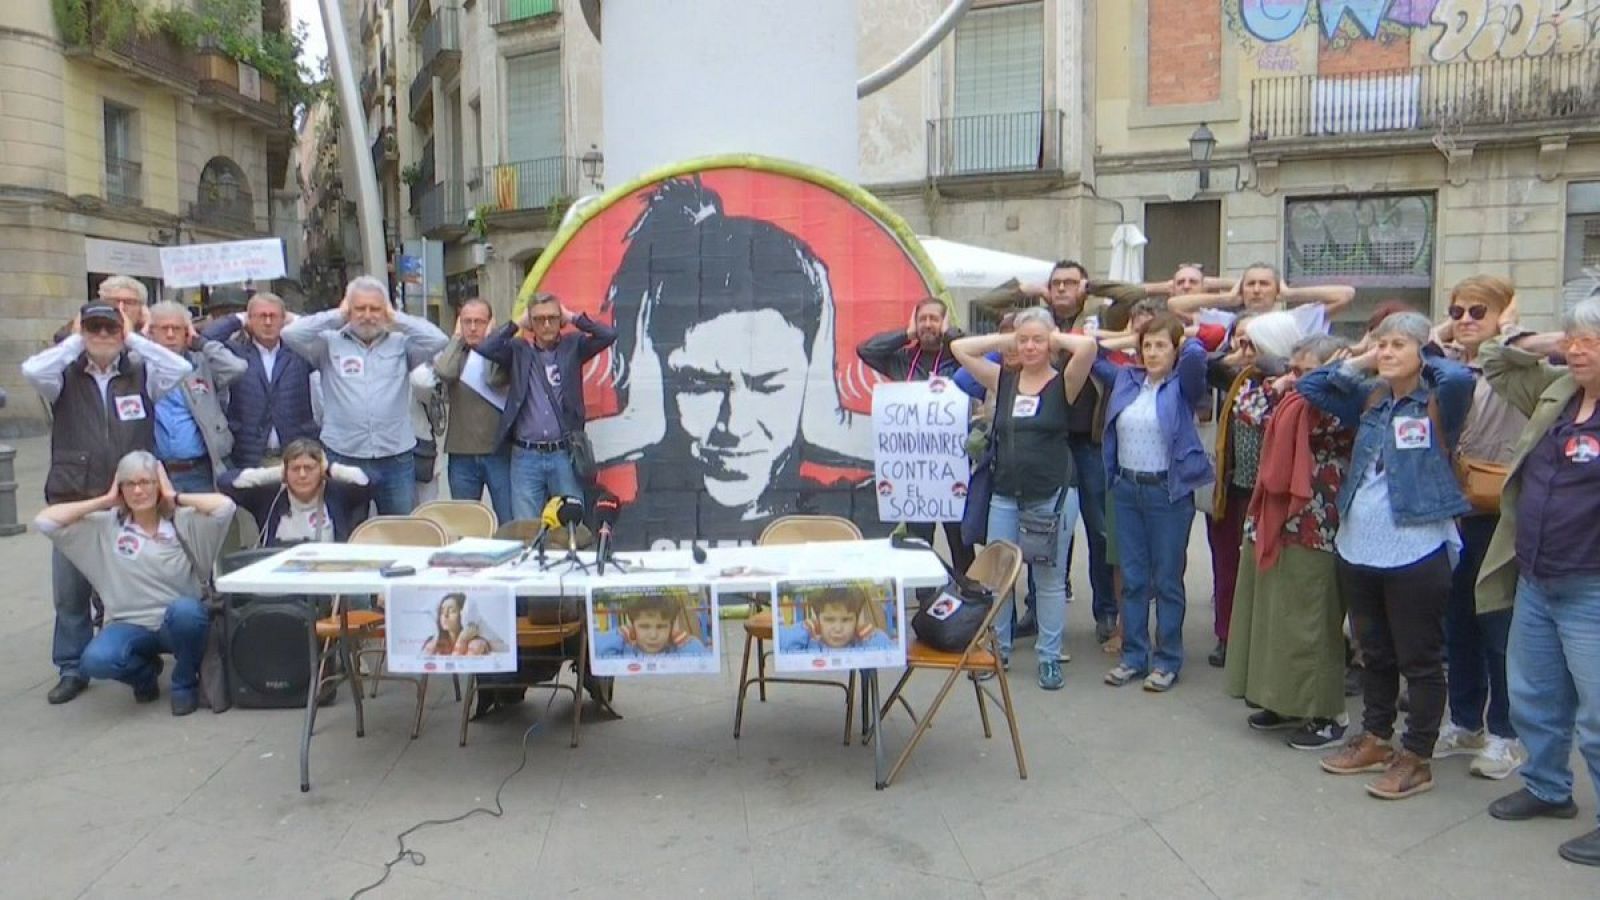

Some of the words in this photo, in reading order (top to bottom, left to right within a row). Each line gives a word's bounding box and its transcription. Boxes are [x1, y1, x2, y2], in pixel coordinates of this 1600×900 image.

[884, 403, 919, 426] SOM
[926, 401, 956, 426] ELS
[878, 431, 966, 459] RONDINAIRES
[880, 460, 956, 481] CONTRA
[906, 484, 922, 498] EL
[889, 498, 958, 519] SOROLL
